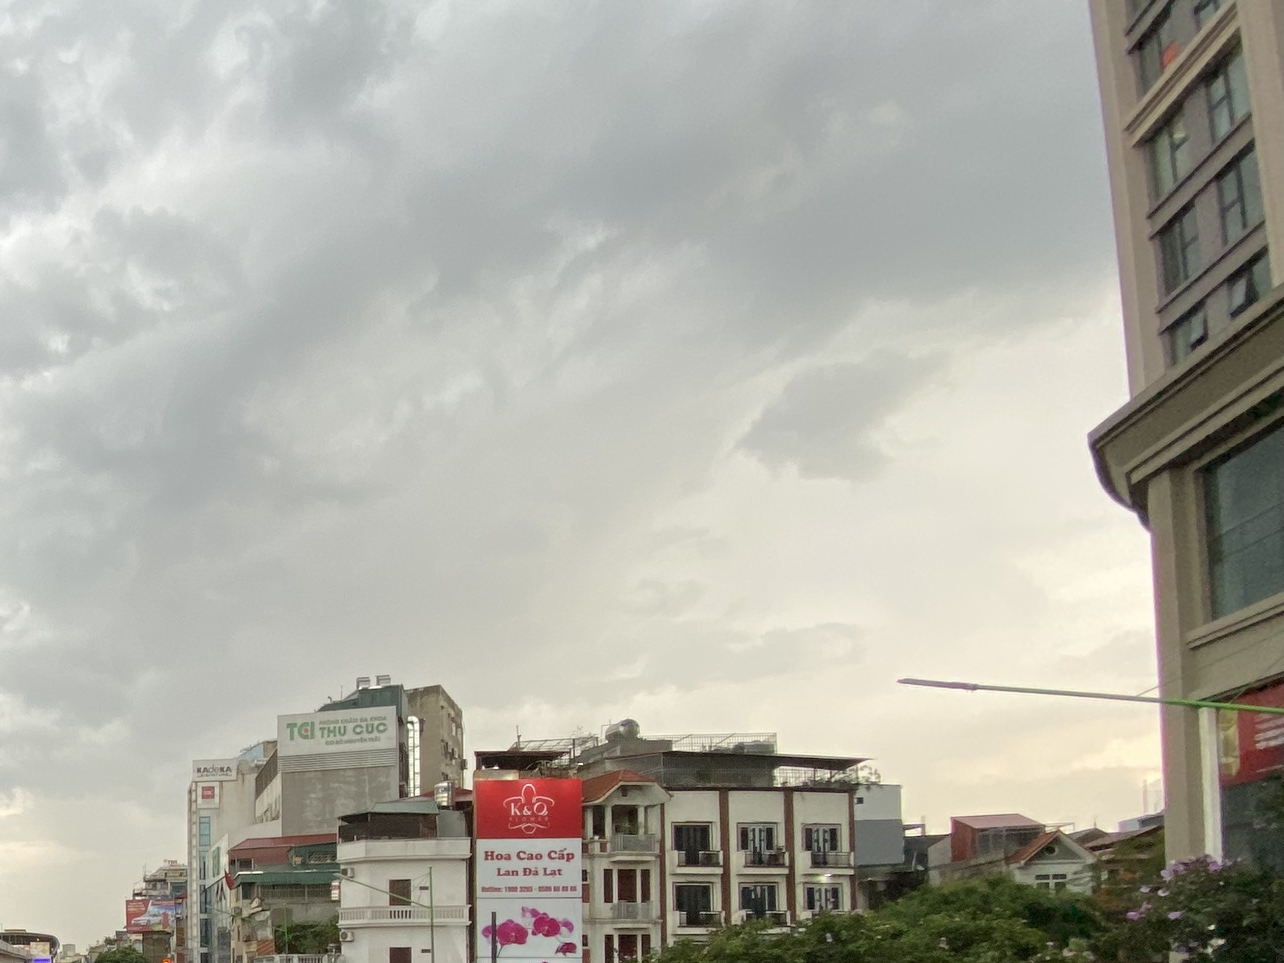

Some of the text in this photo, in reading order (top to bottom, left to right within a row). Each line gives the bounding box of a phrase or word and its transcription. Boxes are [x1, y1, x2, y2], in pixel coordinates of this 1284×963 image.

[484, 848, 575, 862] Hoa Cao Cấp
[496, 867, 519, 877] Lan
